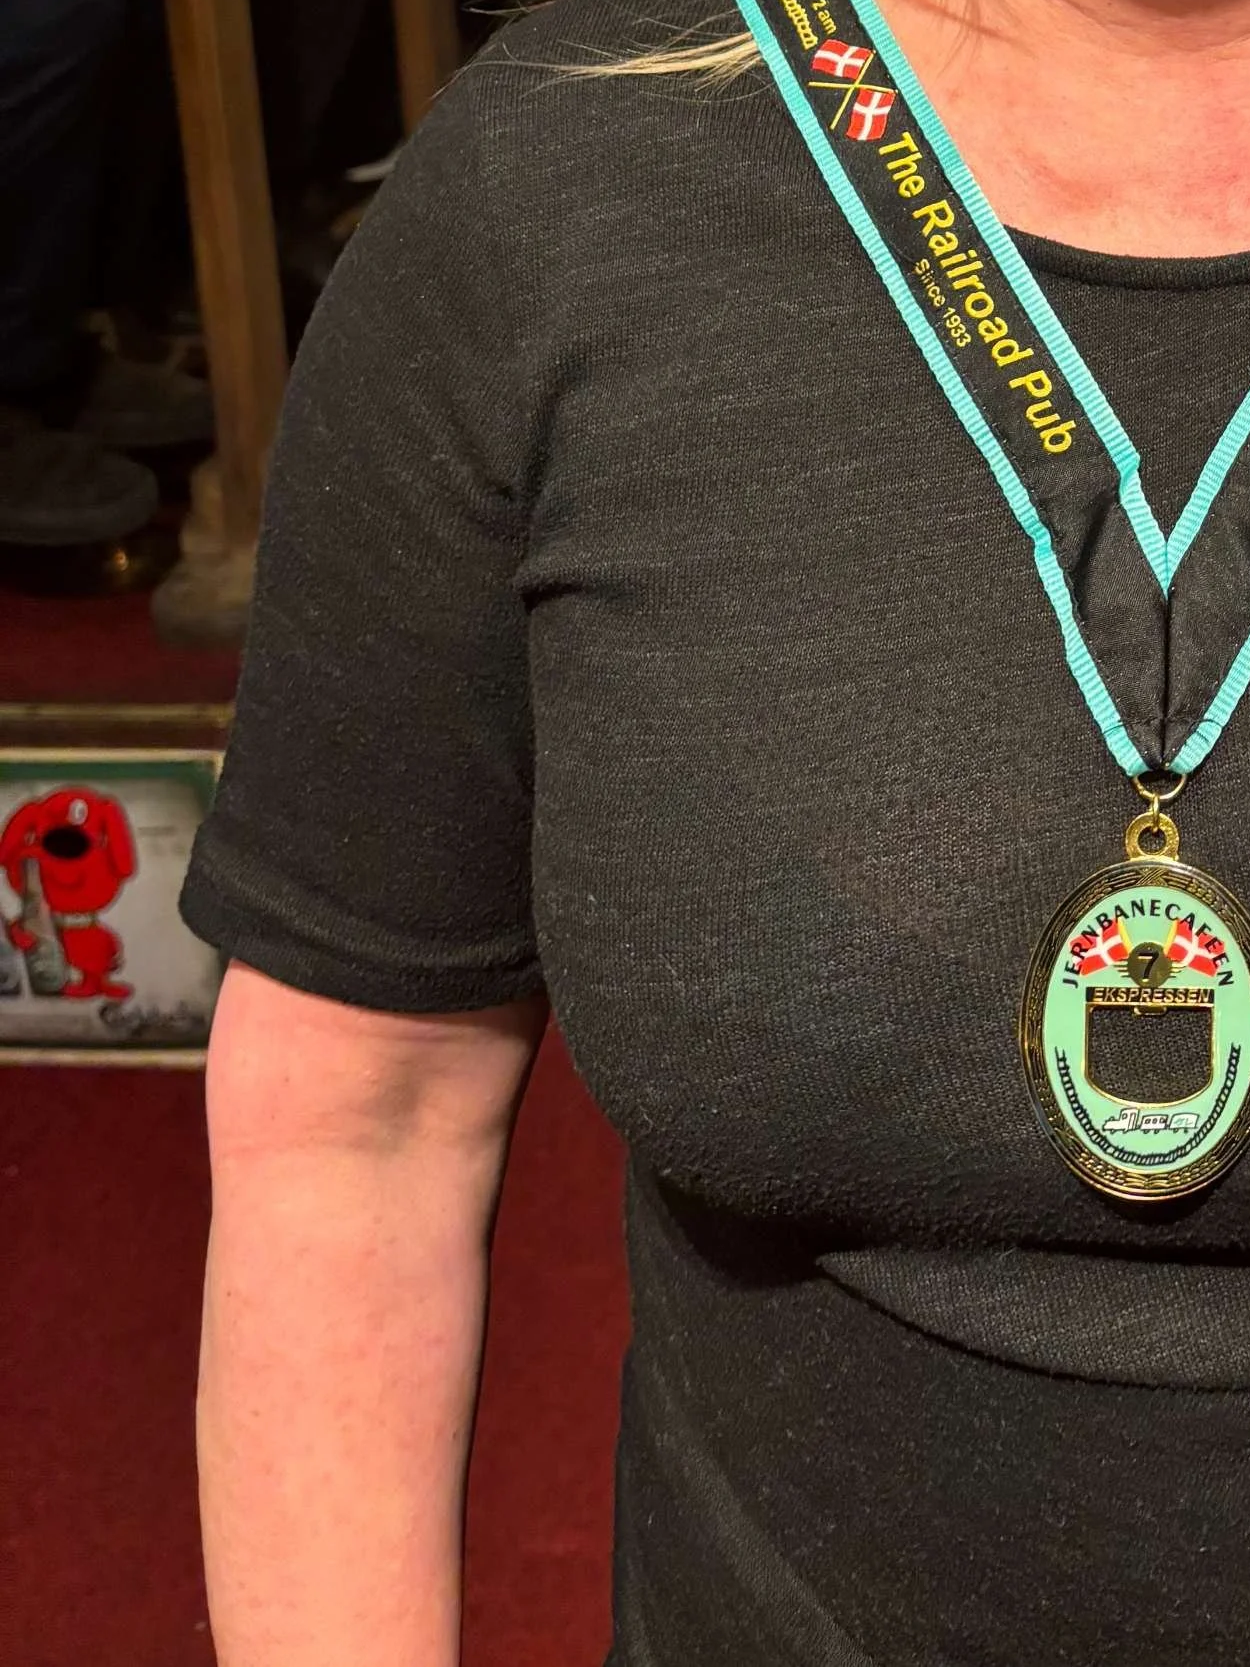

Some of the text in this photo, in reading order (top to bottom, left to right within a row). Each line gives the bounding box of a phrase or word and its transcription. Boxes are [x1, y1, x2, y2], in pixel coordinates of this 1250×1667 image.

[817, 12, 837, 35] am
[878, 131, 1077, 454] The Railroad Pub
[912, 258, 971, 347] Since 1933
[1062, 899, 1235, 988] JERNBANECAFEEN
[1135, 949, 1160, 980] 7
[1092, 987, 1211, 1003] EKSPRESSEN
